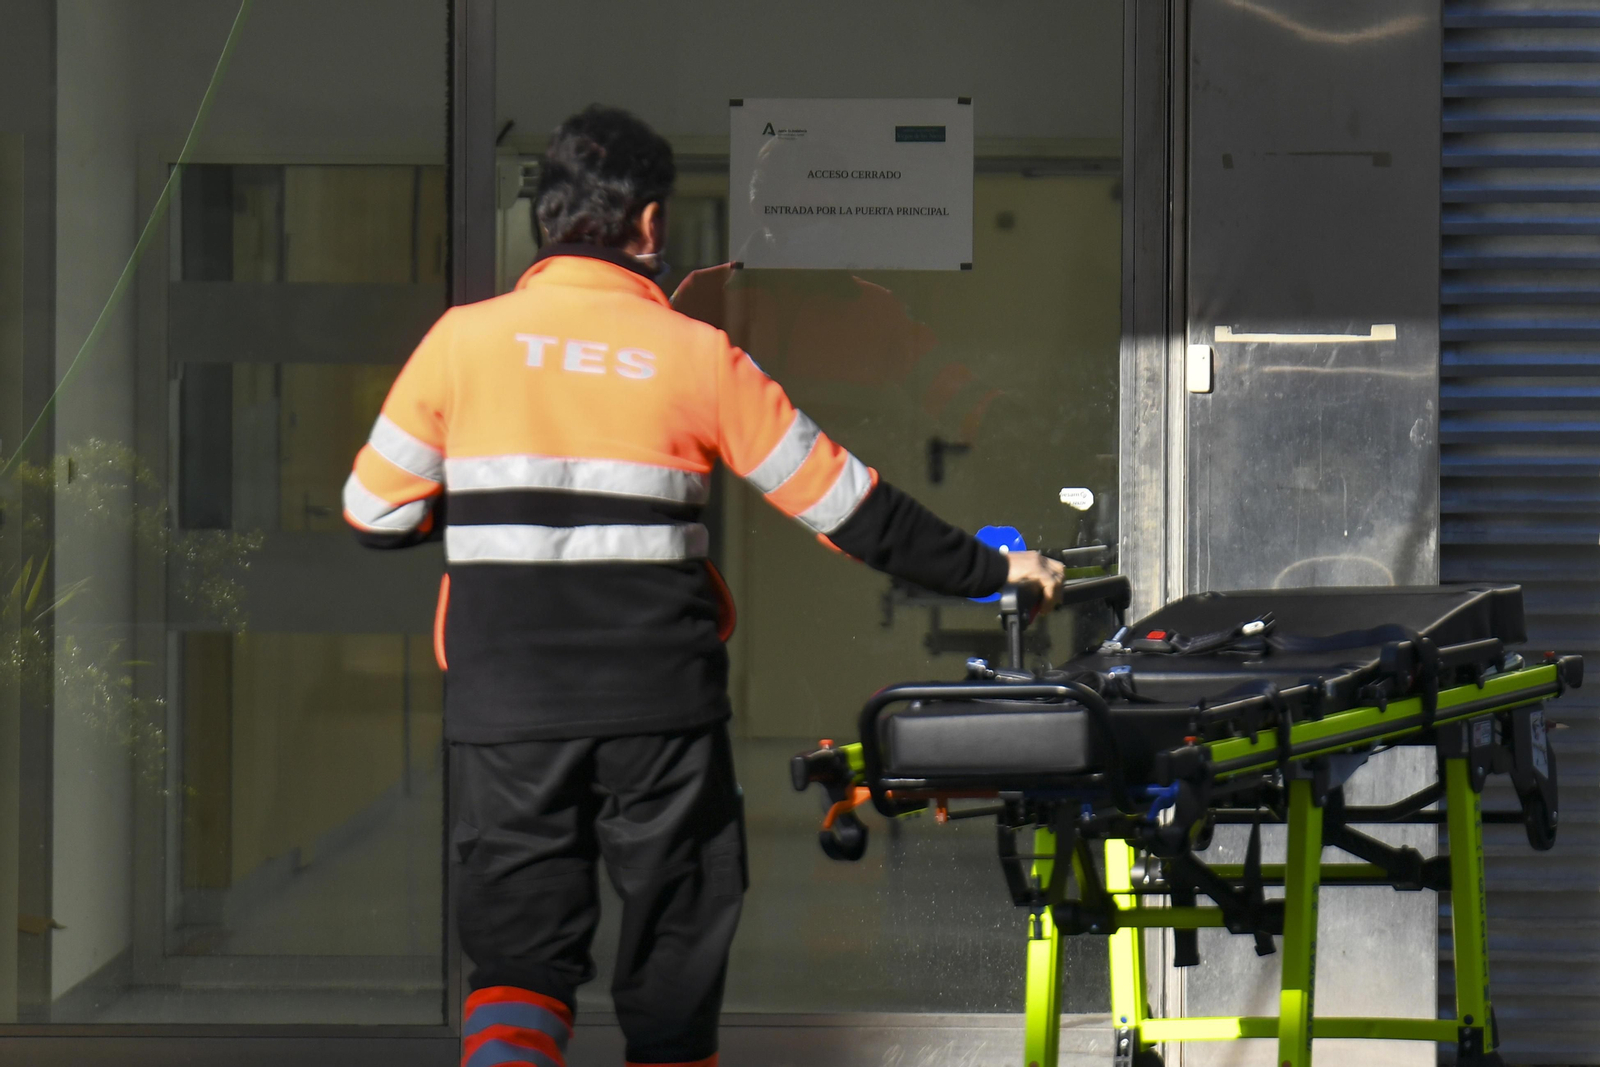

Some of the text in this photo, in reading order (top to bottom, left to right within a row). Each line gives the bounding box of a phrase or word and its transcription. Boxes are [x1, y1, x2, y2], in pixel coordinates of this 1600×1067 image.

[807, 170, 902, 180] ACCESO CERRADO
[764, 205, 950, 217] ENTRADA POR LA PUERTA PRINCIPAL
[514, 332, 658, 380] TES
